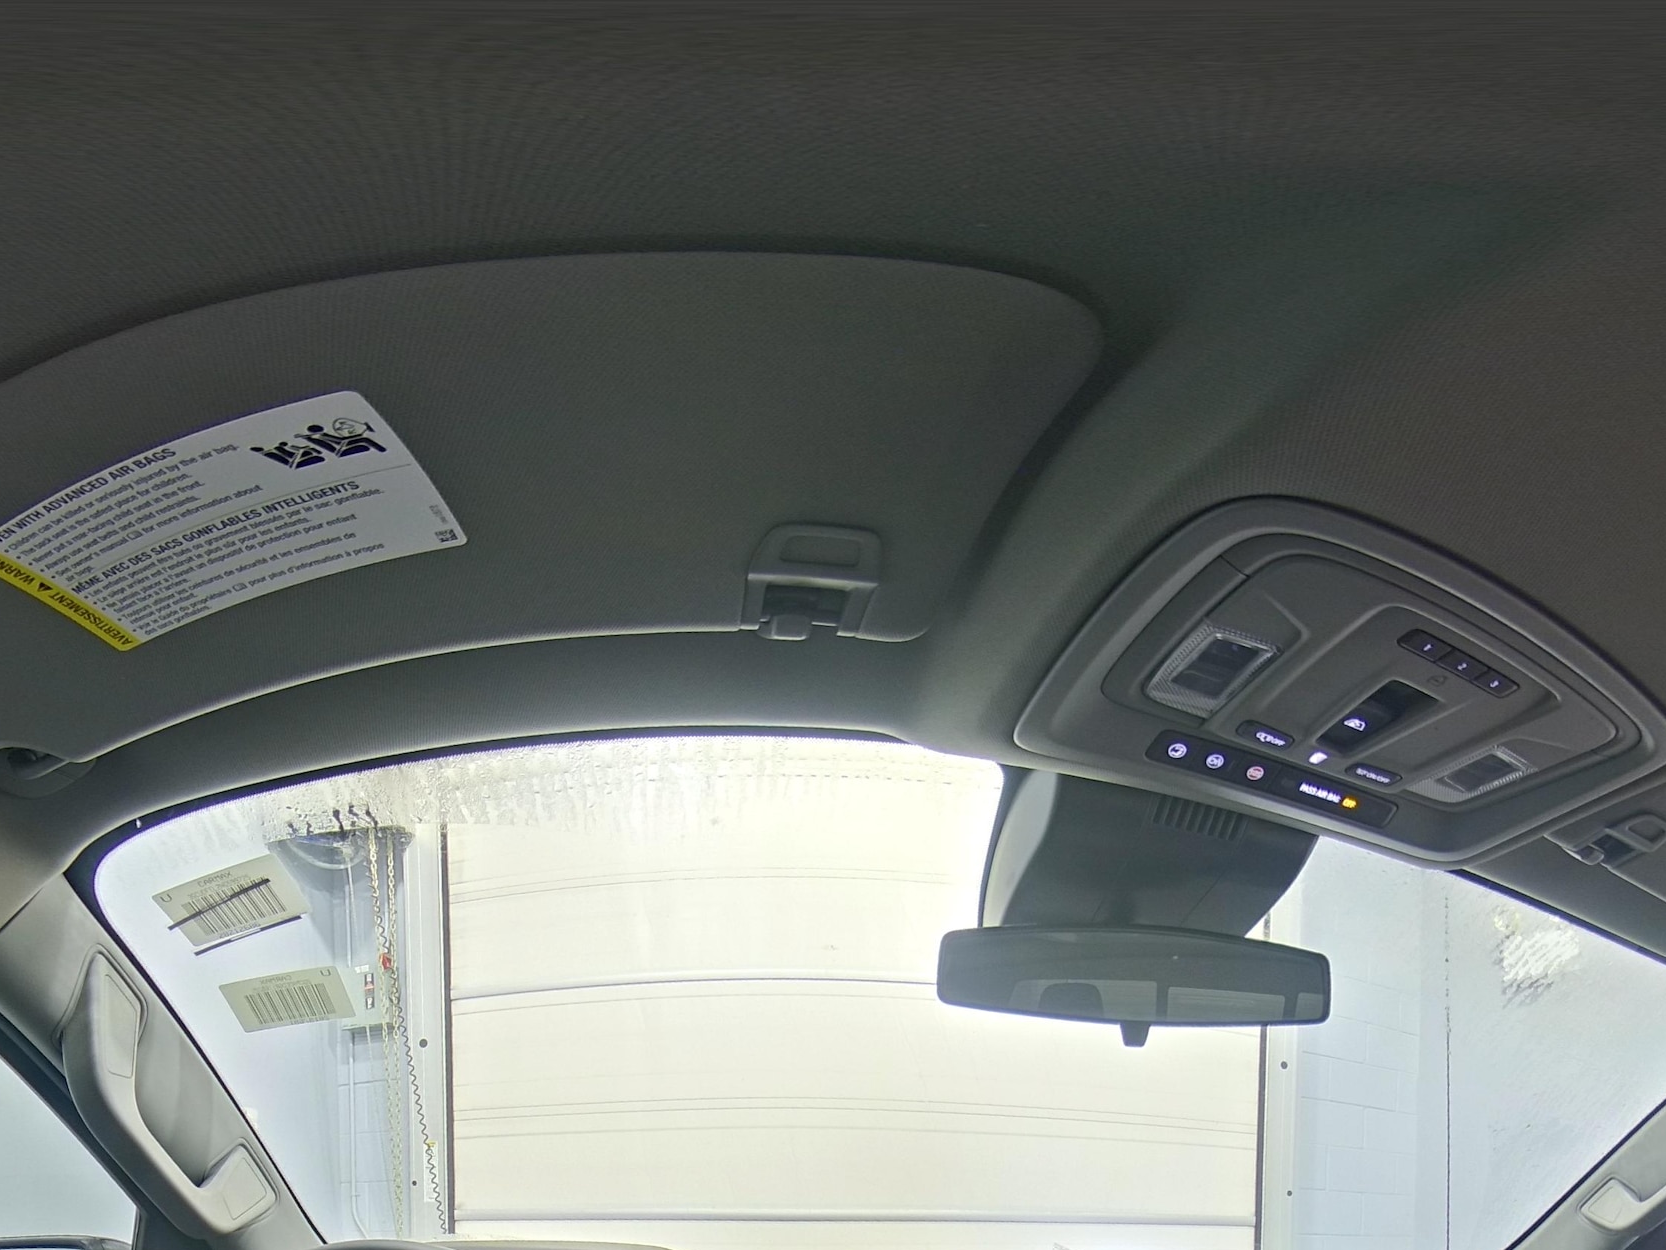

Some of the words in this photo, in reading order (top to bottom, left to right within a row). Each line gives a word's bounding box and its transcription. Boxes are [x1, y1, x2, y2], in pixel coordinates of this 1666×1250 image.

[8, 530, 40, 550] Children
[95, 483, 134, 504] seriously
[134, 468, 166, 487] injured
[165, 463, 181, 474] by
[179, 457, 198, 467] the
[198, 451, 214, 460] air
[13, 510, 45, 530] WITH
[42, 477, 109, 513] ADVANCED
[108, 465, 135, 481] AIR
[133, 448, 177, 469] BAGS
[137, 487, 152, 497] for
[162, 486, 179, 497] the
[142, 524, 155, 534] for
[180, 494, 233, 518] information
[233, 484, 264, 499] about
[285, 508, 302, 519] par
[314, 500, 332, 509] sac
[303, 522, 325, 535] pour
[326, 512, 358, 526] enfant
[71, 575, 103, 595] MÊME
[102, 562, 131, 580] AVEC
[128, 551, 152, 566] DES
[150, 538, 183, 557] SACS
[182, 508, 262, 543] GONFLABLES
[261, 481, 361, 515] INTELLIGENTS
[47, 591, 133, 647] AVERTISSEMENT
[1299, 782, 1317, 796] PASS
[1326, 791, 1341, 804] BAG
[1342, 797, 1358, 809] OFF
